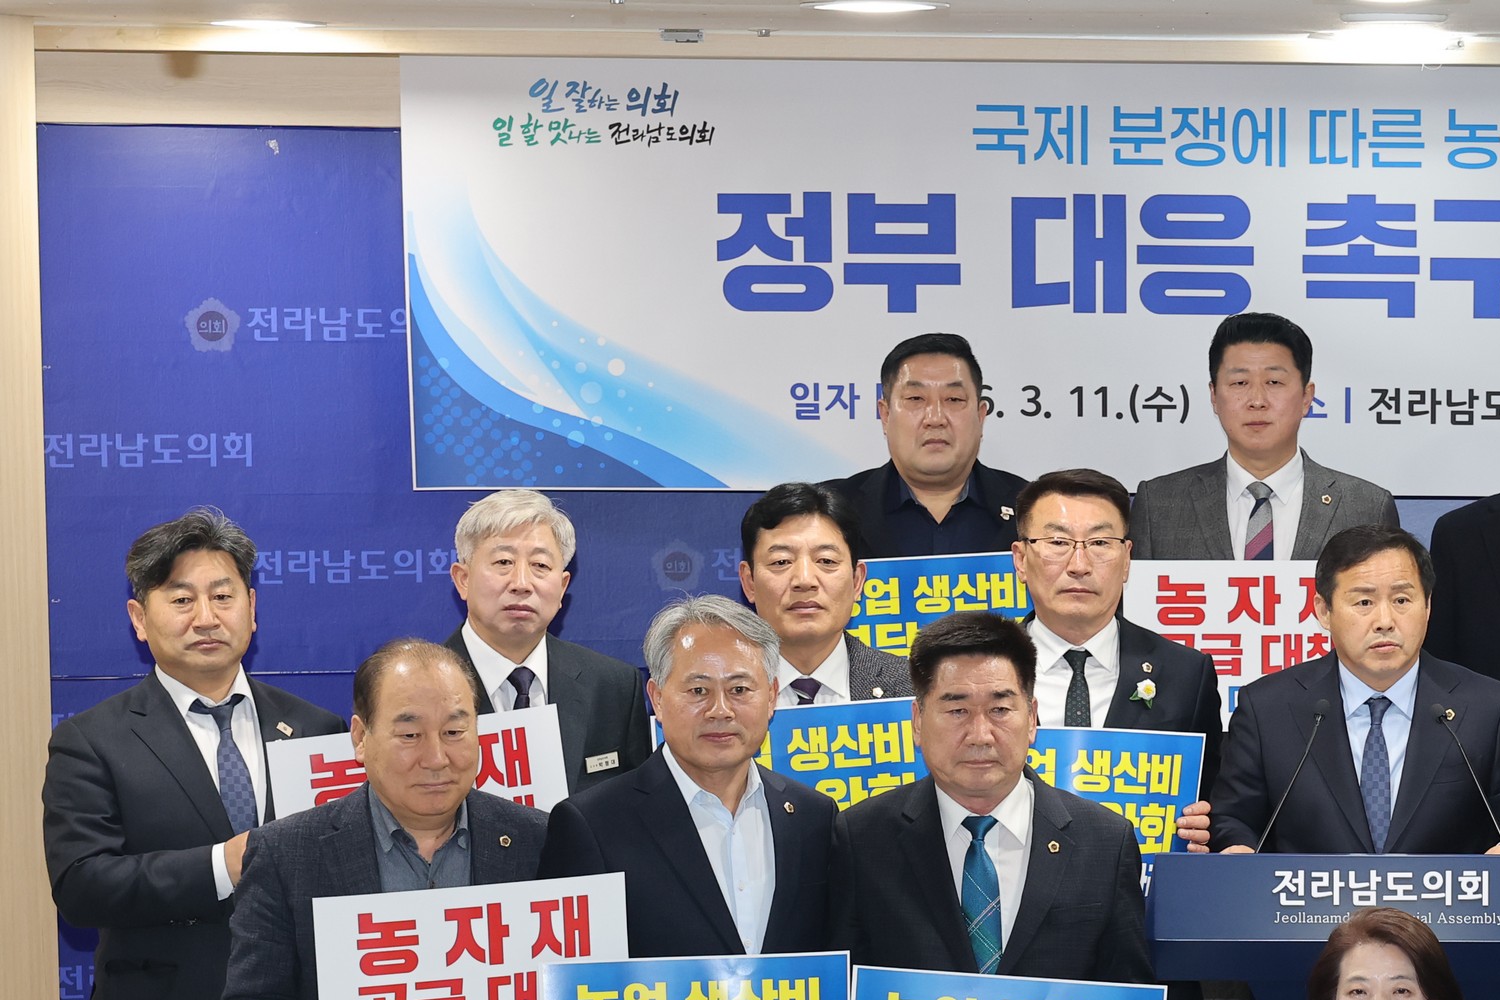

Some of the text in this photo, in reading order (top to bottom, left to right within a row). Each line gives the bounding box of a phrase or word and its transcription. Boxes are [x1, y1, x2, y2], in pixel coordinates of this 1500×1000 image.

[626, 82, 679, 117] 의회
[608, 121, 716, 148] 전라남도의회
[972, 104, 1089, 166] 국제
[1109, 105, 1287, 168] 분쟁에
[1309, 108, 1425, 168] 따른
[716, 191, 961, 313] 정부
[1011, 194, 1254, 315] 대응
[247, 307, 408, 341] 전라남도
[789, 381, 861, 421] 일자
[1020, 385, 1051, 419] 3.
[1070, 384, 1190, 424] 11.(수)
[45, 433, 253, 468] 전라남도의회
[914, 573, 1027, 613] 생산비
[1159, 633, 1244, 677] 급
[788, 720, 915, 771] 생산비
[1071, 749, 1183, 796] 생산비
[1272, 869, 1490, 907] 전라남도의회
[1273, 911, 1349, 925] Jeollanamd
